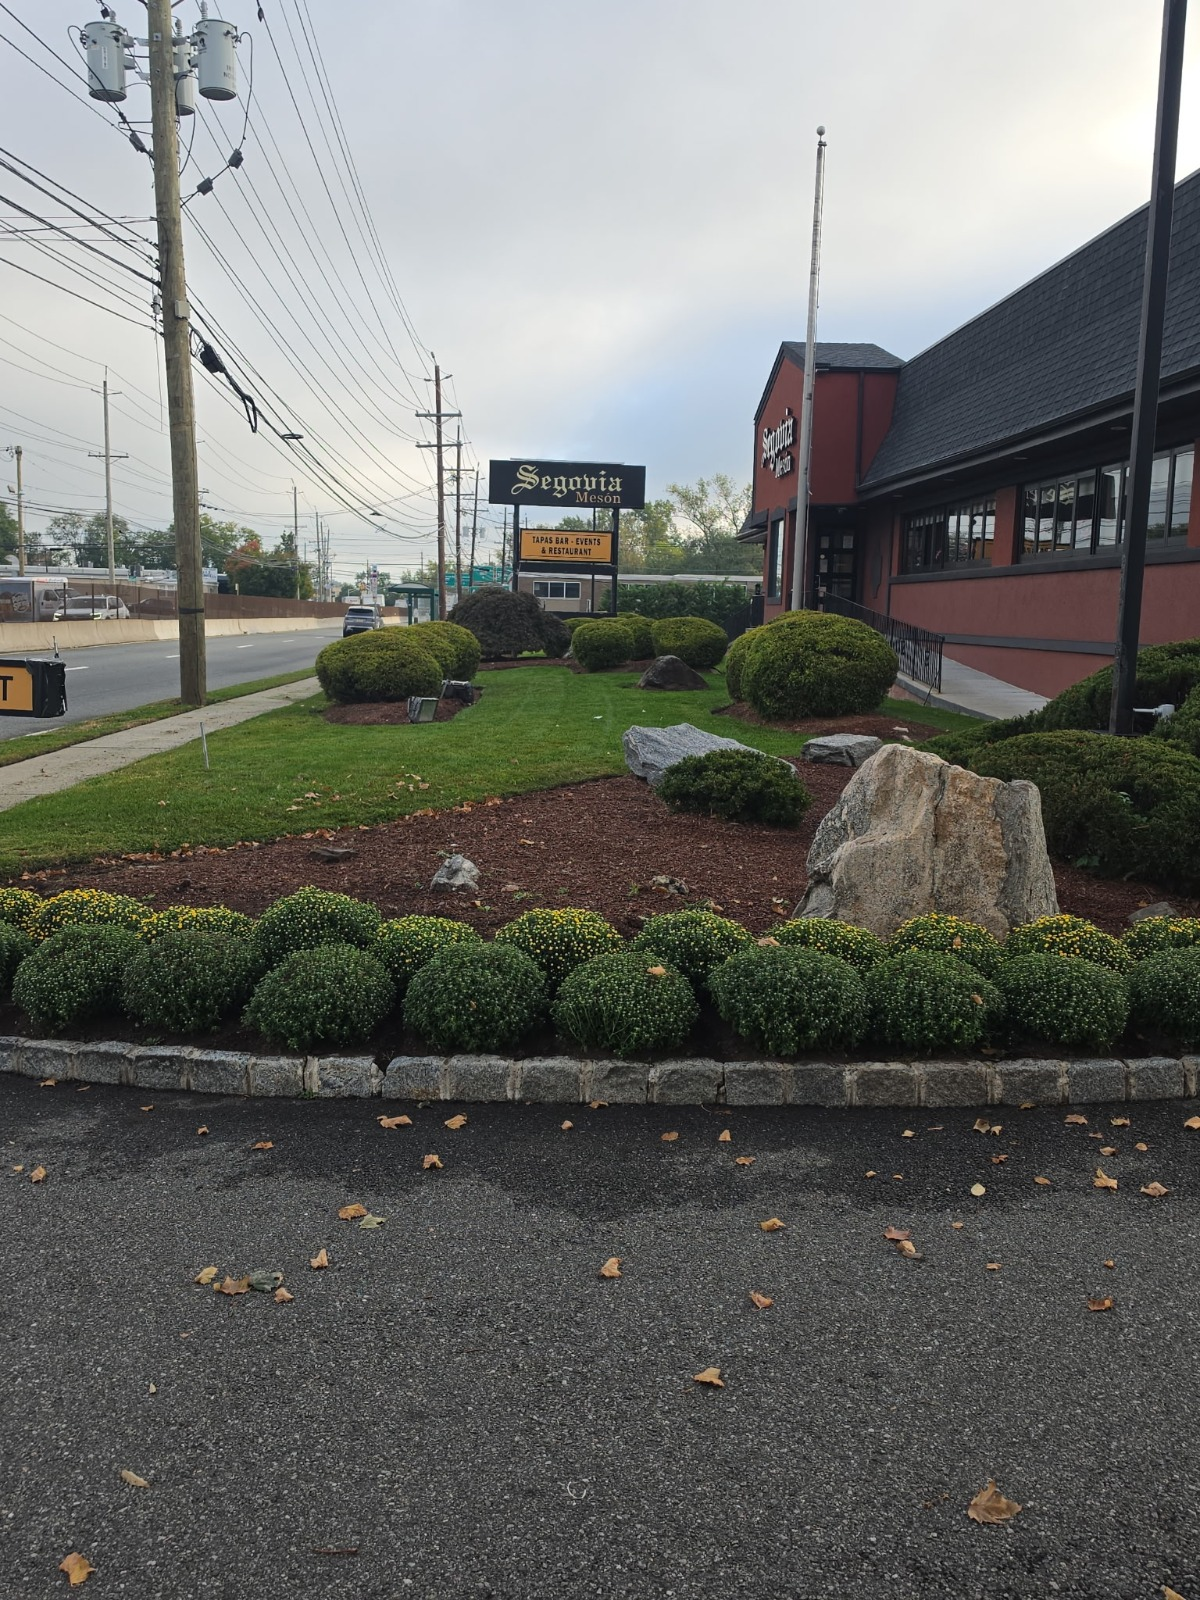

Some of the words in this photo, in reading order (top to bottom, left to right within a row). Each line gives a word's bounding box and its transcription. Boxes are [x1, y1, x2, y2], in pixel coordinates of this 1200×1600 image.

[510, 464, 623, 498] Segovia
[575, 491, 621, 504] Mesón
[532, 536, 553, 545] TAPAS
[555, 537, 569, 545] BAR
[576, 537, 601, 546] EVENTS
[541, 547, 547, 555] &
[548, 546, 592, 556] RESTAURANT
